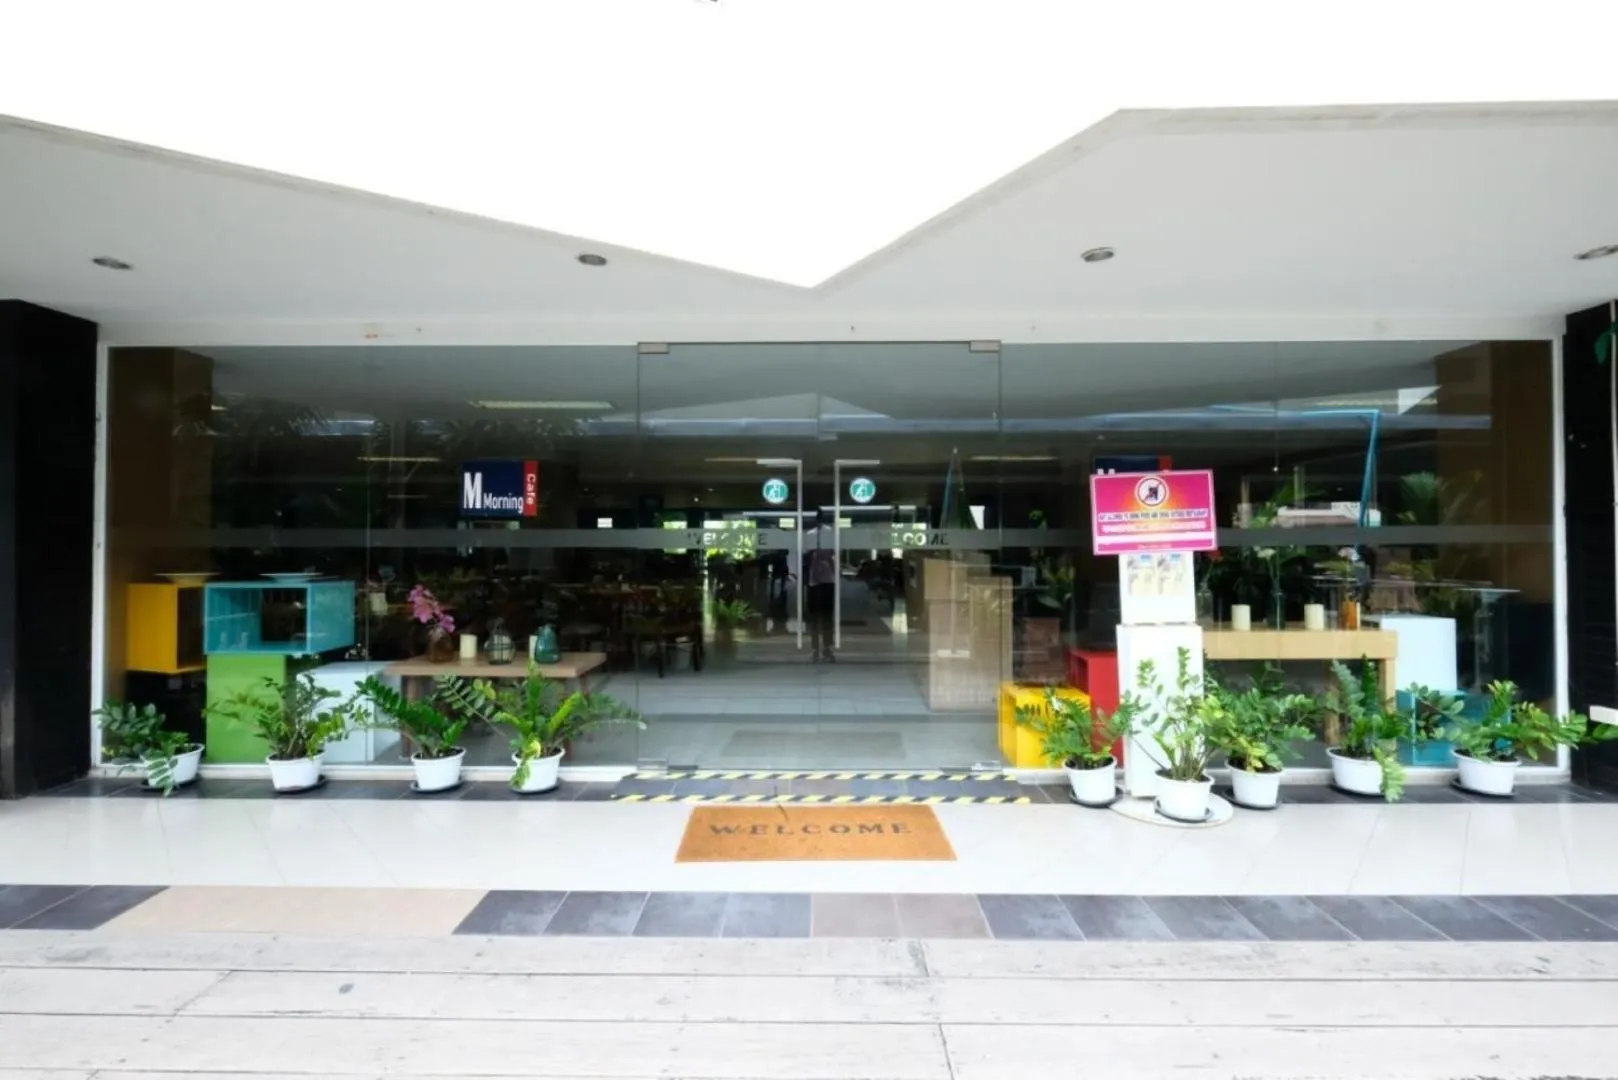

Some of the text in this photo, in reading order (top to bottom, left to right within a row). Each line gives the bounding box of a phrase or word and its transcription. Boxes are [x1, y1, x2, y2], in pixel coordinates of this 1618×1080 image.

[464, 472, 524, 514] M Morning
[526, 473, 536, 505] Cafe
[708, 823, 912, 836] WELCOME
